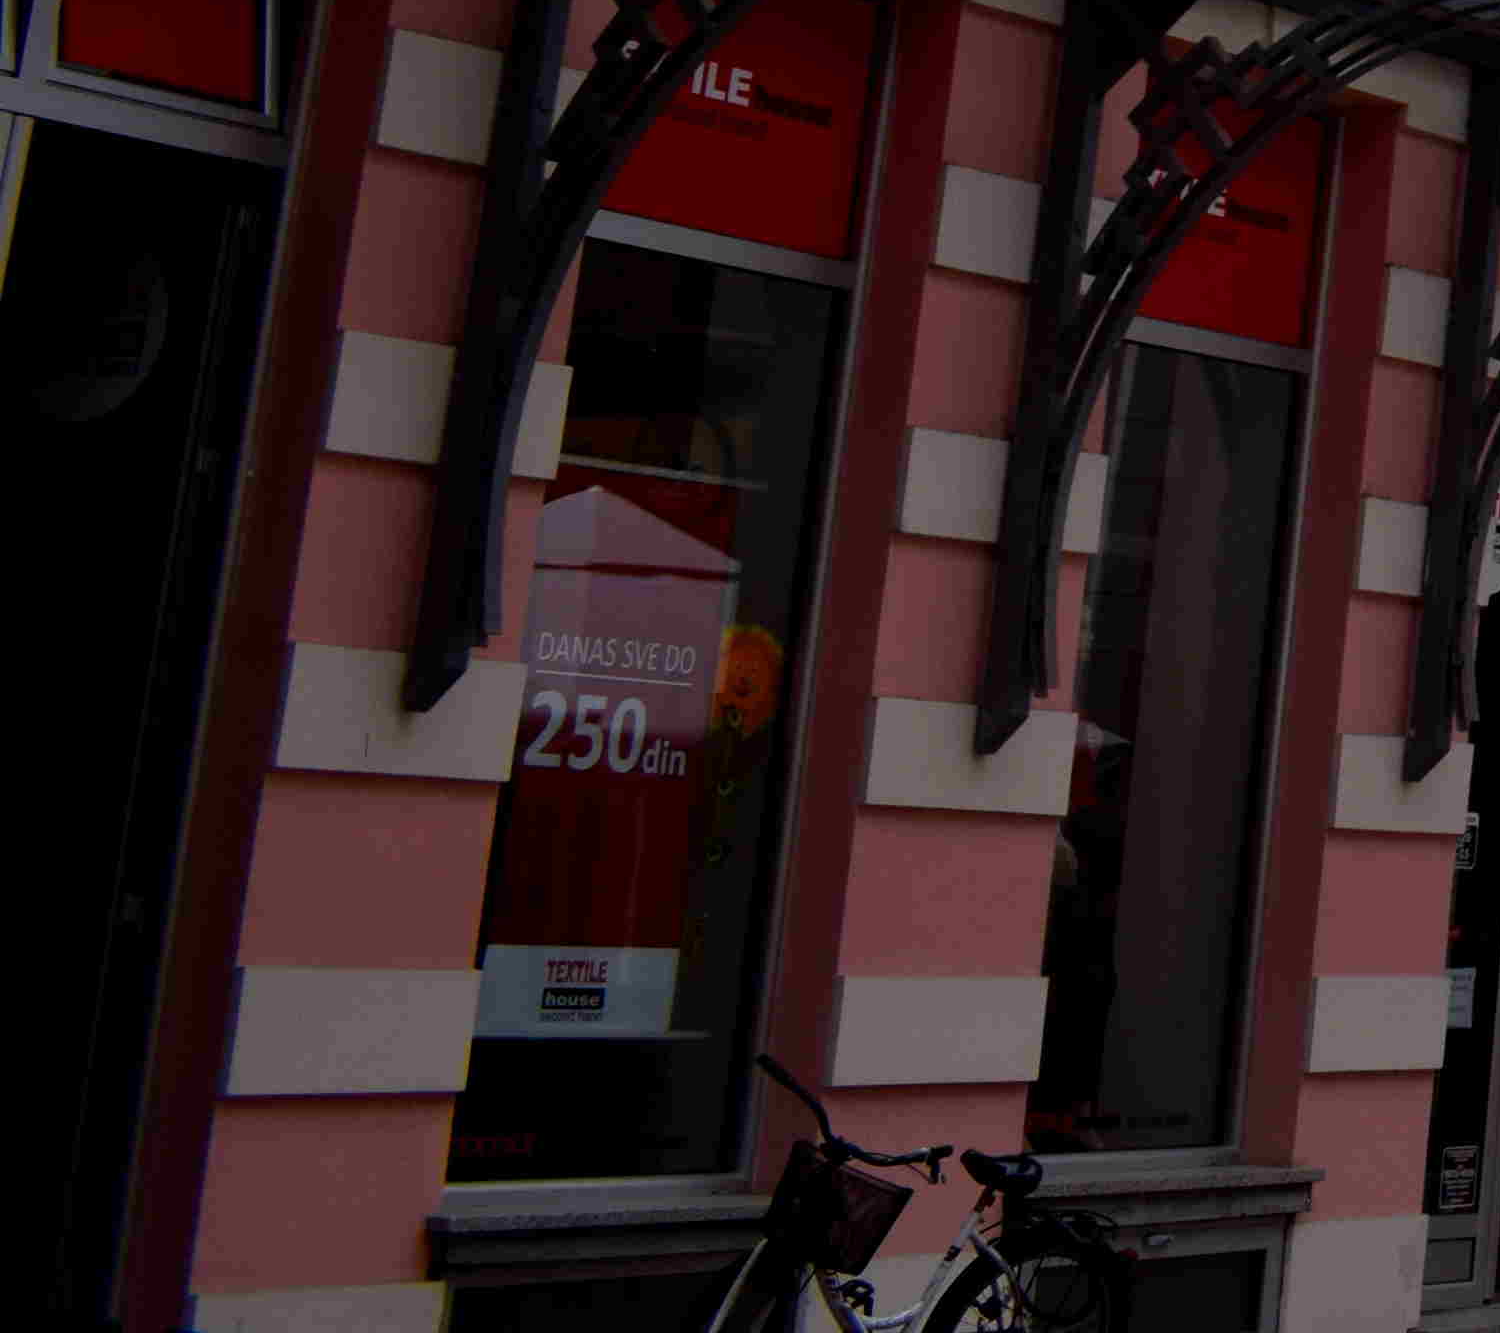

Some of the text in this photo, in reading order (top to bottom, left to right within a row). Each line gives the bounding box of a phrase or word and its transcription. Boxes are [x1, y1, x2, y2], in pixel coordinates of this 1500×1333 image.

[537, 631, 697, 675] DANAS SVE DO
[546, 960, 609, 983] TEXTILE
[545, 989, 602, 1007] house
